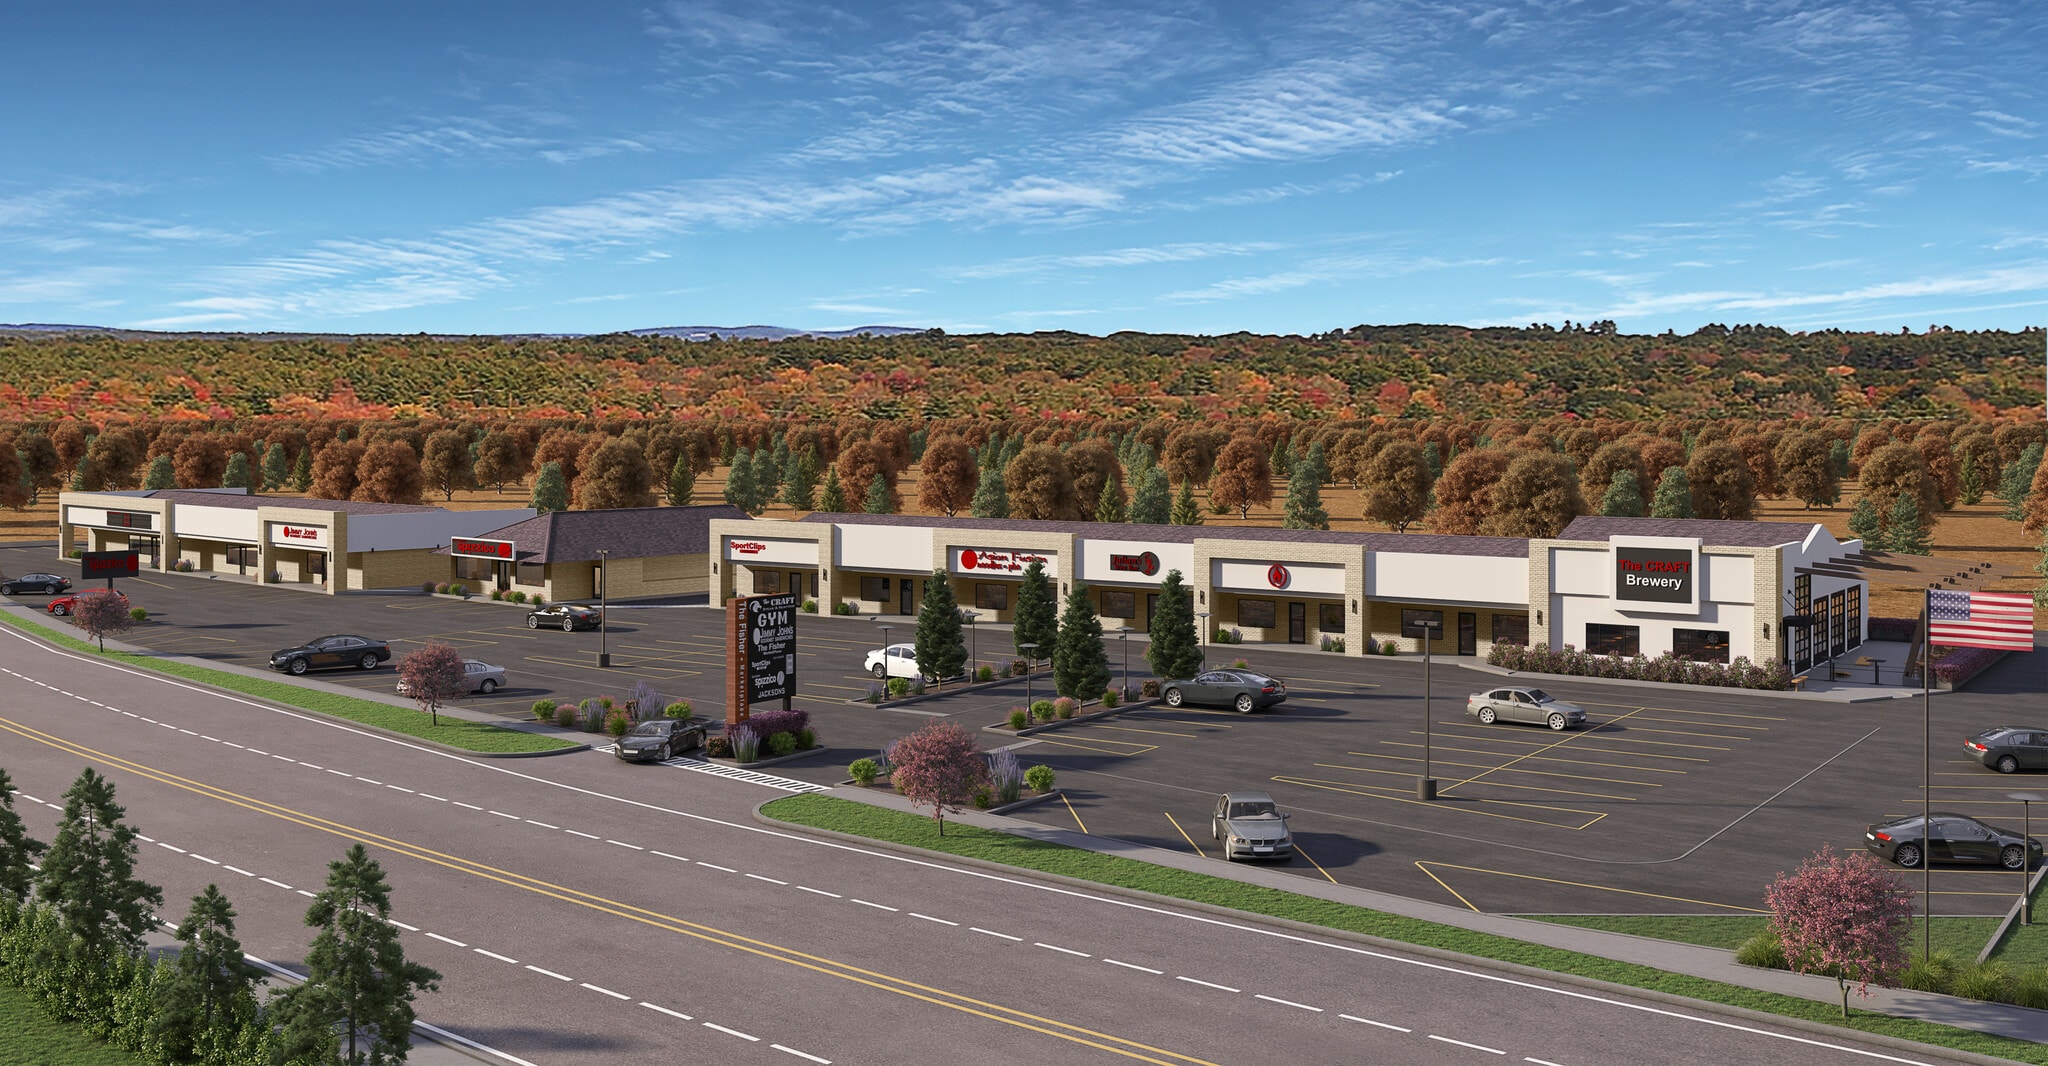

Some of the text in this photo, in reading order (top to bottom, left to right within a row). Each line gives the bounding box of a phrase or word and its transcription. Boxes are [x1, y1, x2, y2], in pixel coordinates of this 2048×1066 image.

[457, 541, 496, 555] spizzico
[730, 541, 766, 551] SportClips
[978, 551, 1009, 562] Asian
[1618, 559, 1691, 573] The CRAFT
[1626, 574, 1682, 591] Brewery
[770, 596, 795, 606] CRAFT
[738, 601, 747, 620] The
[757, 610, 788, 627] GYM
[738, 623, 747, 654] Fisher
[757, 642, 786, 652] The Fisher
[754, 673, 777, 688] spizzico
[757, 687, 786, 698] JACKSONS
